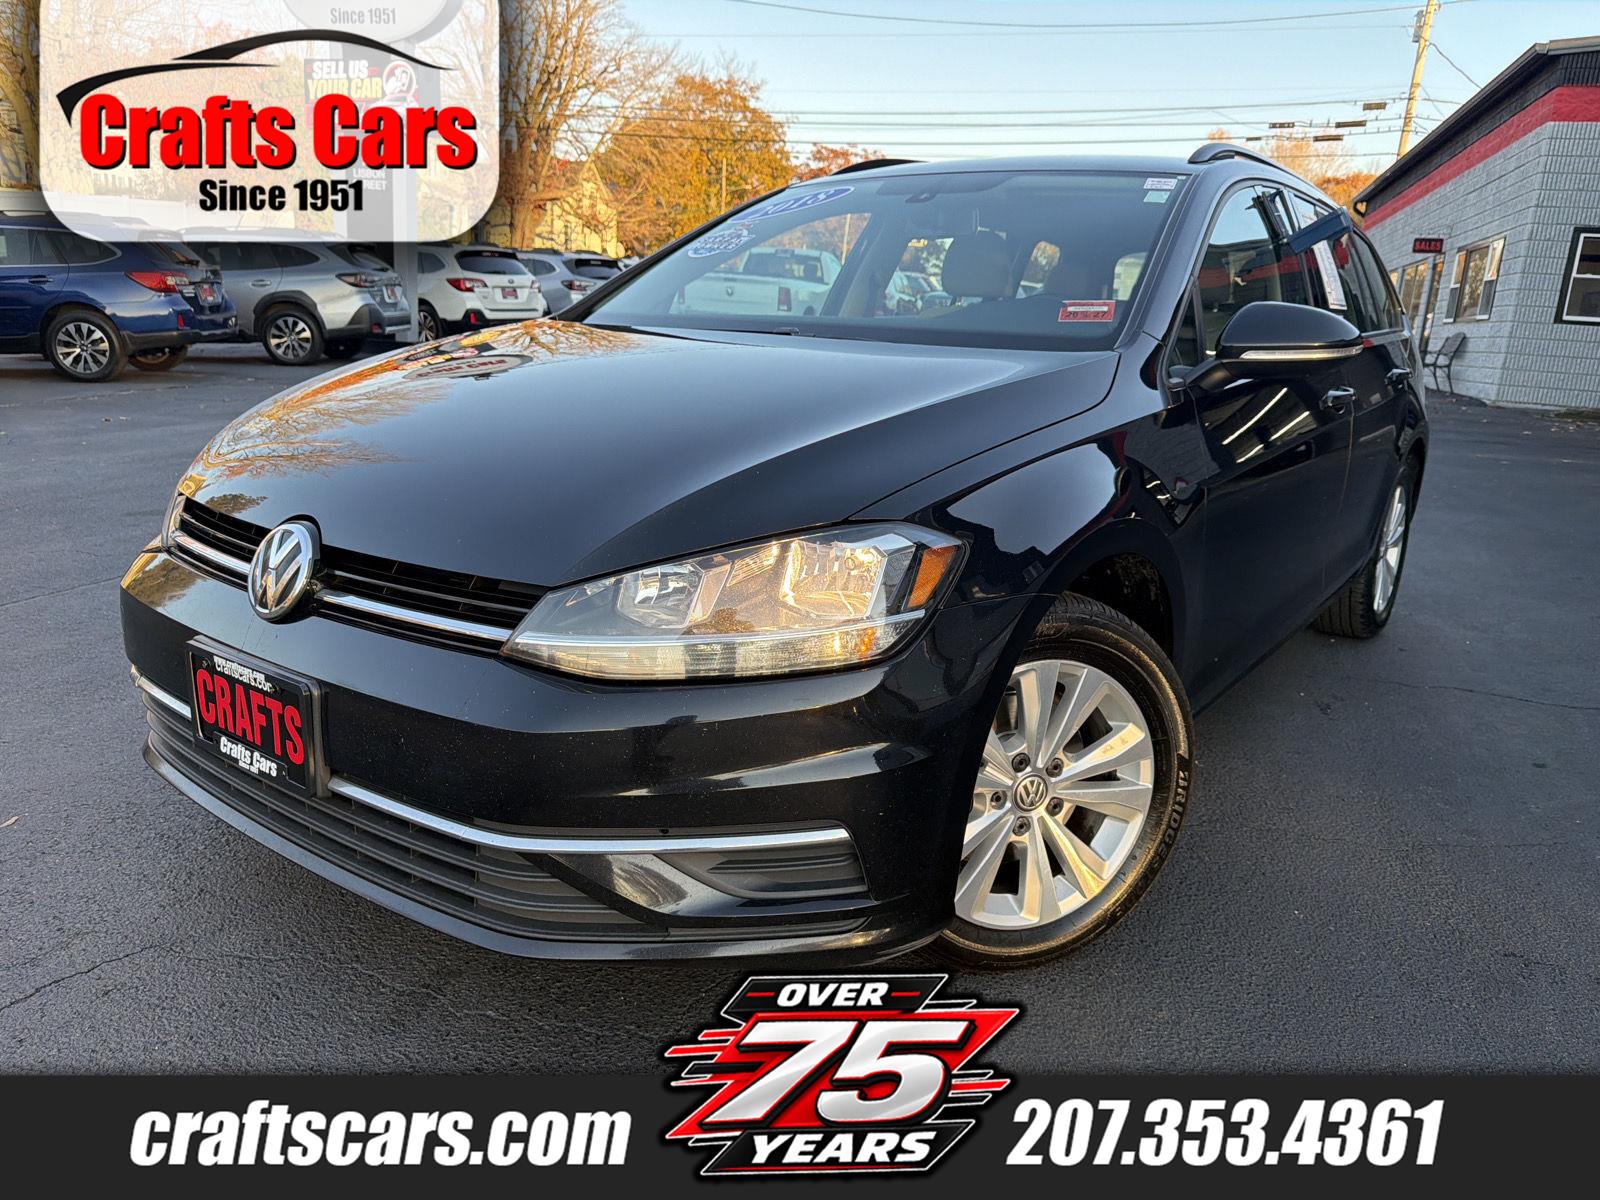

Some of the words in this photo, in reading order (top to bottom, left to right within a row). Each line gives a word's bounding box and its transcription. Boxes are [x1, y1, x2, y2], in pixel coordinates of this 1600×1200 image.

[330, 7, 365, 24] Since
[368, 8, 396, 24] 1951
[312, 61, 347, 79] SELL
[348, 60, 369, 79] US
[307, 79, 349, 98] YOUR
[351, 77, 382, 98] CAR
[1414, 241, 1442, 250] SALES
[196, 668, 304, 765] CRAFTS
[220, 736, 252, 765] Crafts
[252, 751, 277, 777] Cars
